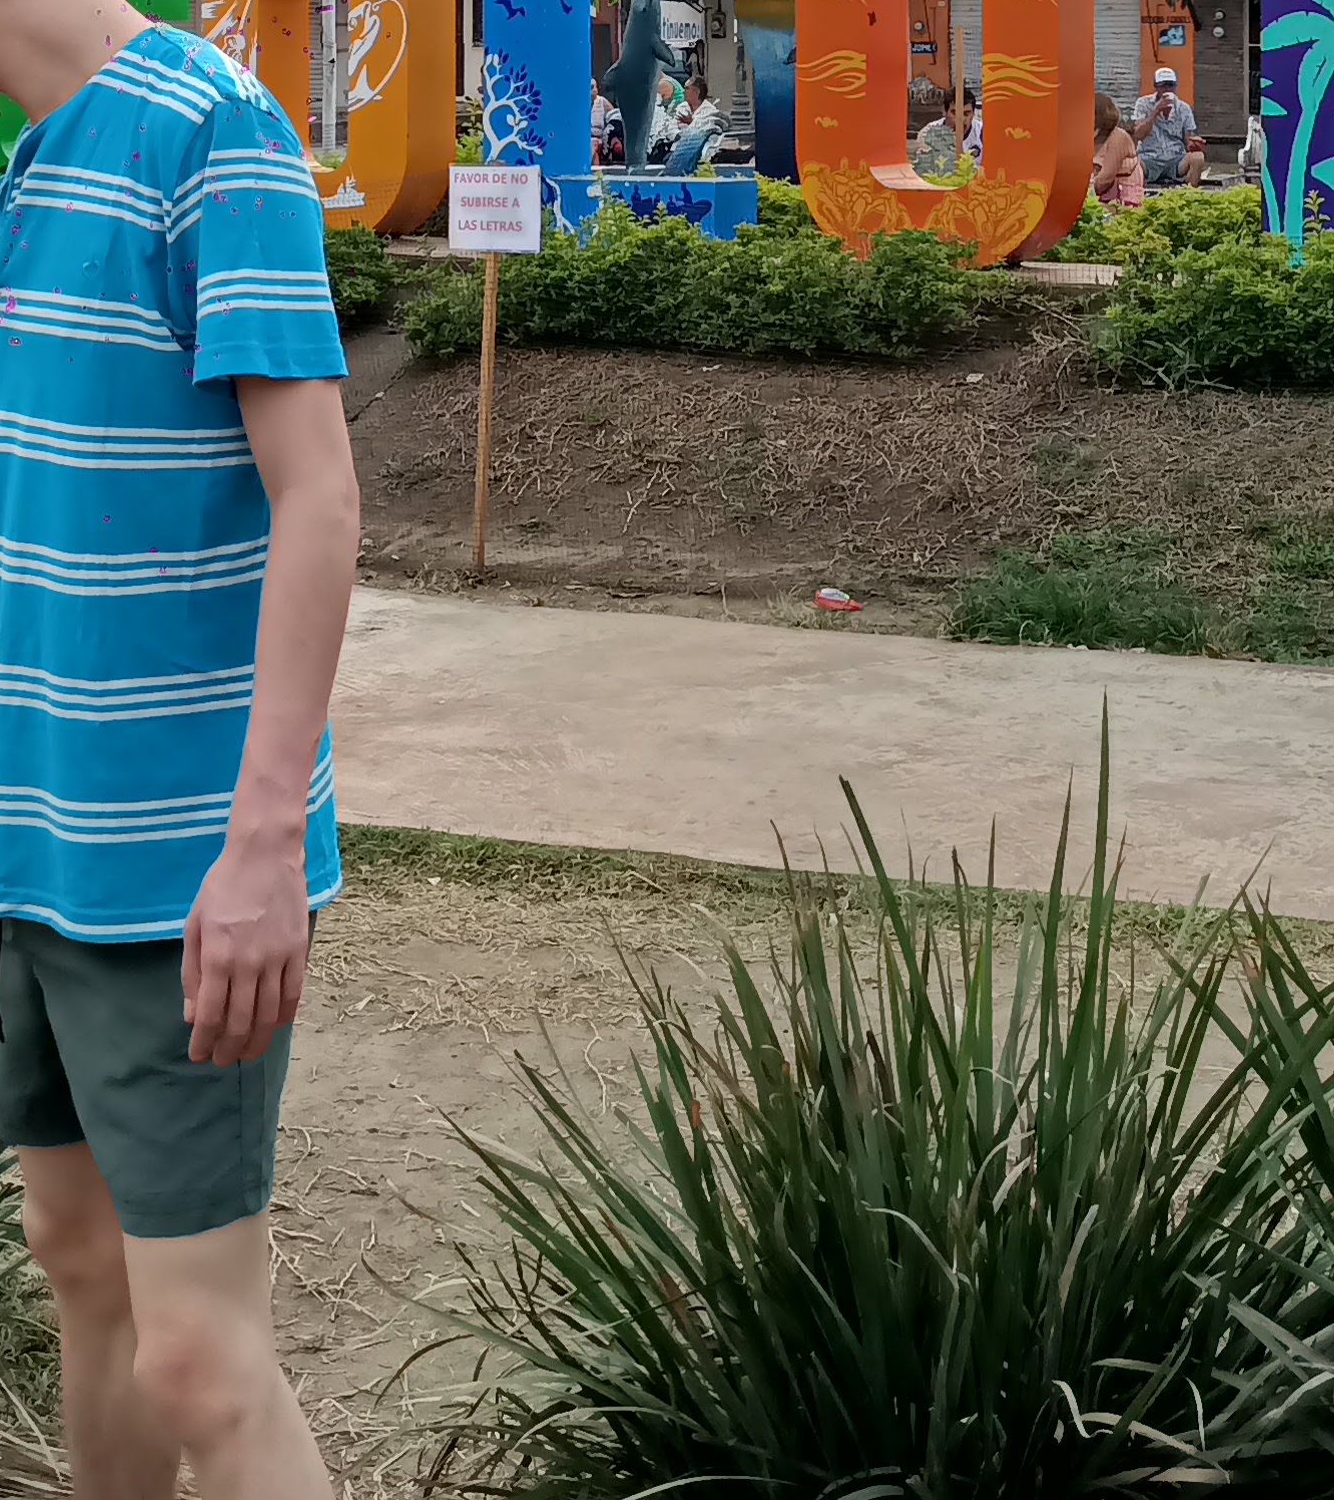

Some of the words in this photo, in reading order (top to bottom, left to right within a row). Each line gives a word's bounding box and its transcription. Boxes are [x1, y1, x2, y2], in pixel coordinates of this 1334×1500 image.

[454, 173, 489, 184] FAVOR
[492, 173, 507, 184] DE
[511, 173, 529, 185] NO
[460, 196, 508, 208] SUBIRSE
[512, 197, 520, 208] A
[458, 219, 478, 231] LAS
[480, 220, 523, 232] LETRAS
